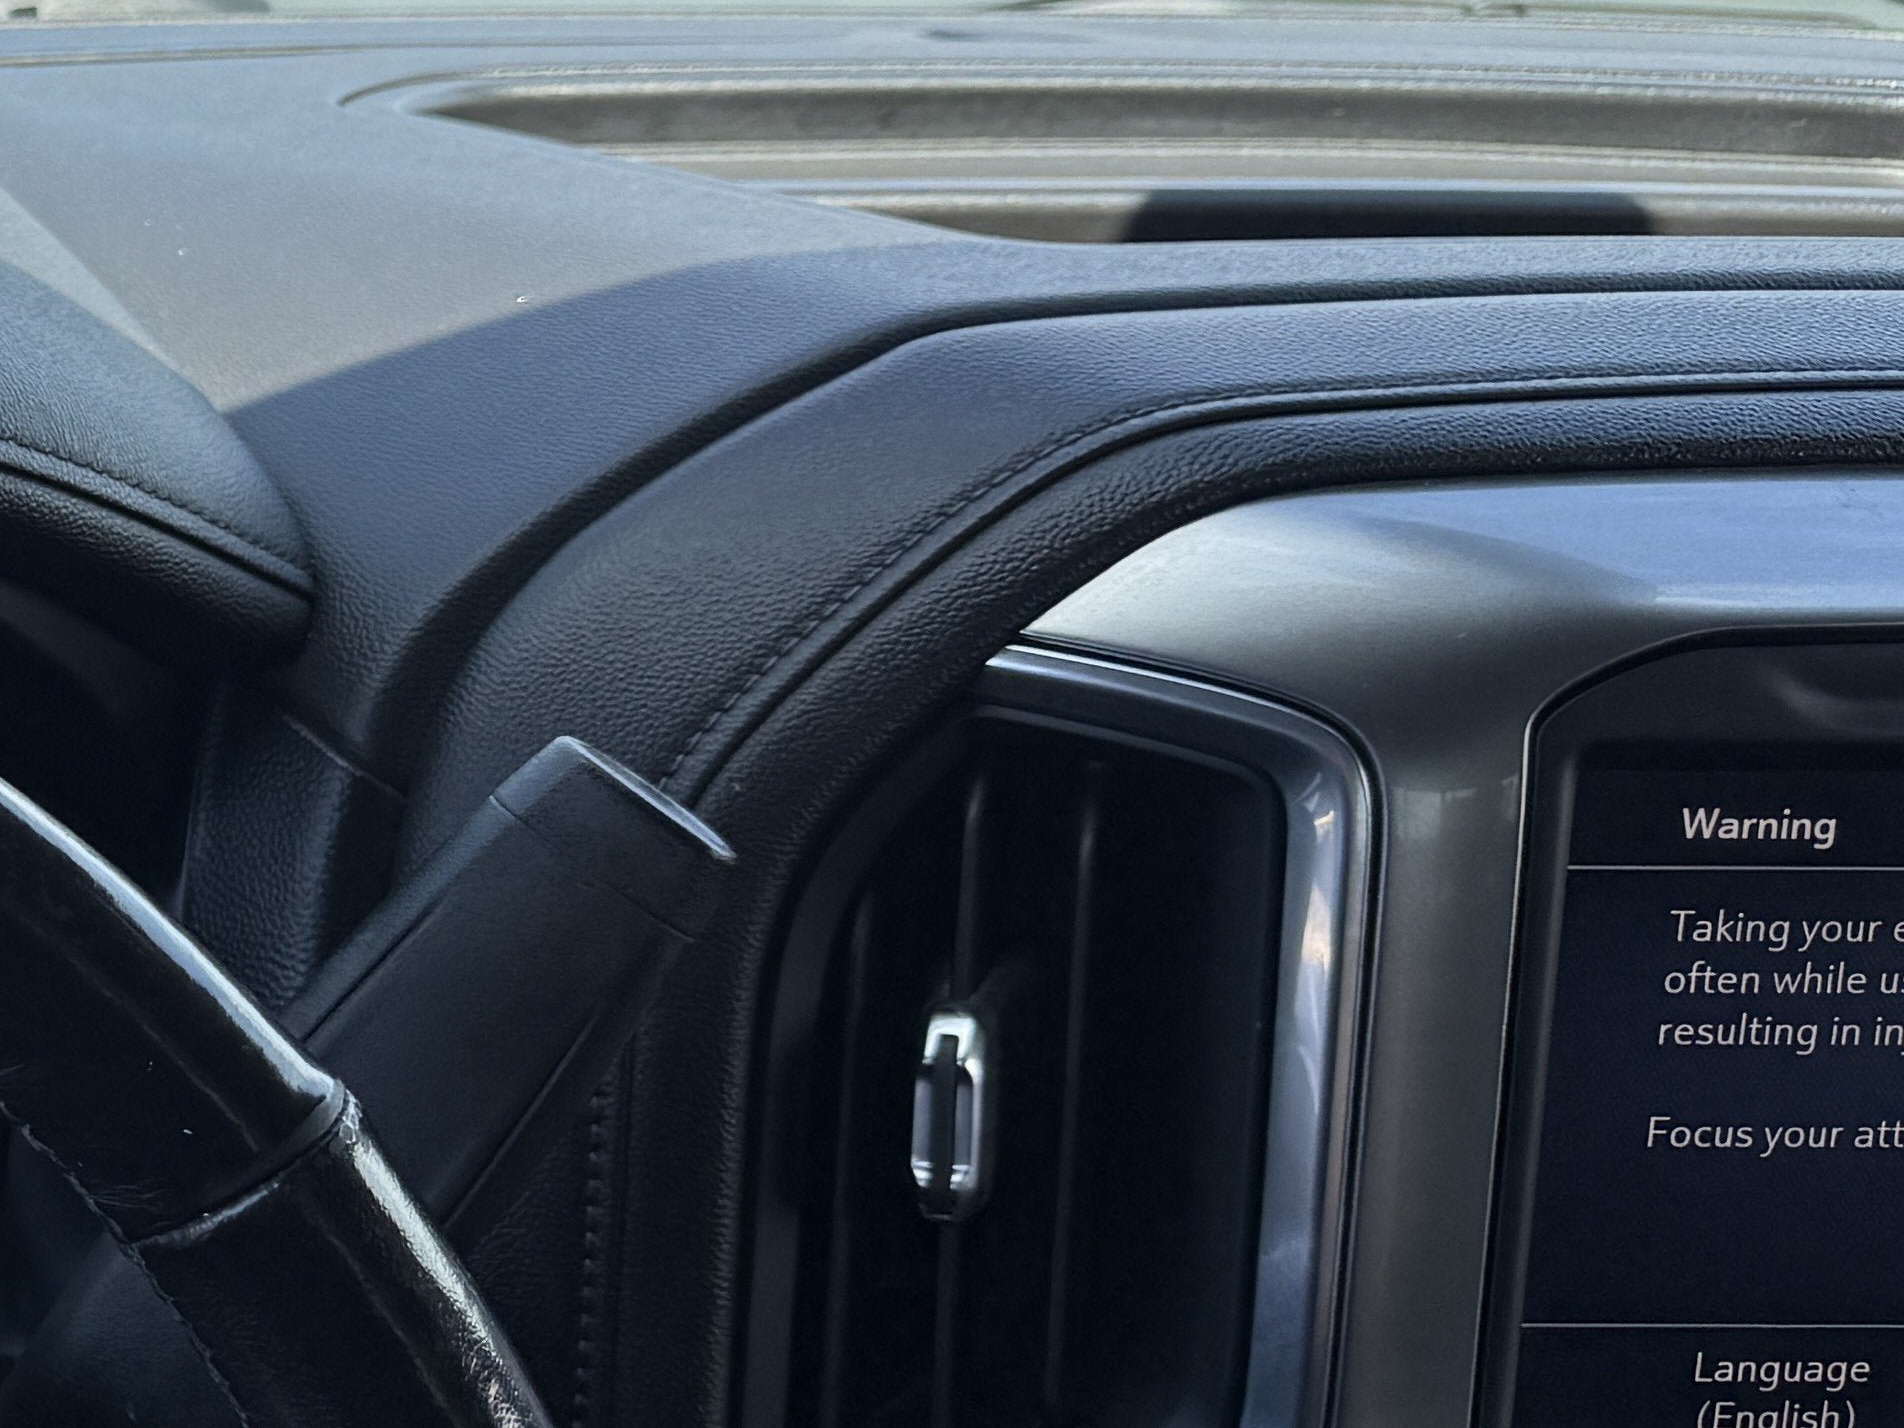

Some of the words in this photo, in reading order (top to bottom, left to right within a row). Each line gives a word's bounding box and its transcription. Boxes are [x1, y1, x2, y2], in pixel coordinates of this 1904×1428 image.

[1682, 807, 1837, 850] Warning
[1670, 908, 1790, 952] Taking
[1798, 920, 1883, 952] your
[1664, 960, 1760, 994] often
[1773, 961, 1867, 994] while
[1658, 1012, 1818, 1056] resulting
[1830, 1016, 1861, 1046] in
[1874, 1016, 1904, 1056] in
[1647, 1116, 1753, 1148] Focus
[1761, 1126, 1844, 1158] your
[1694, 1351, 1871, 1391] Language
